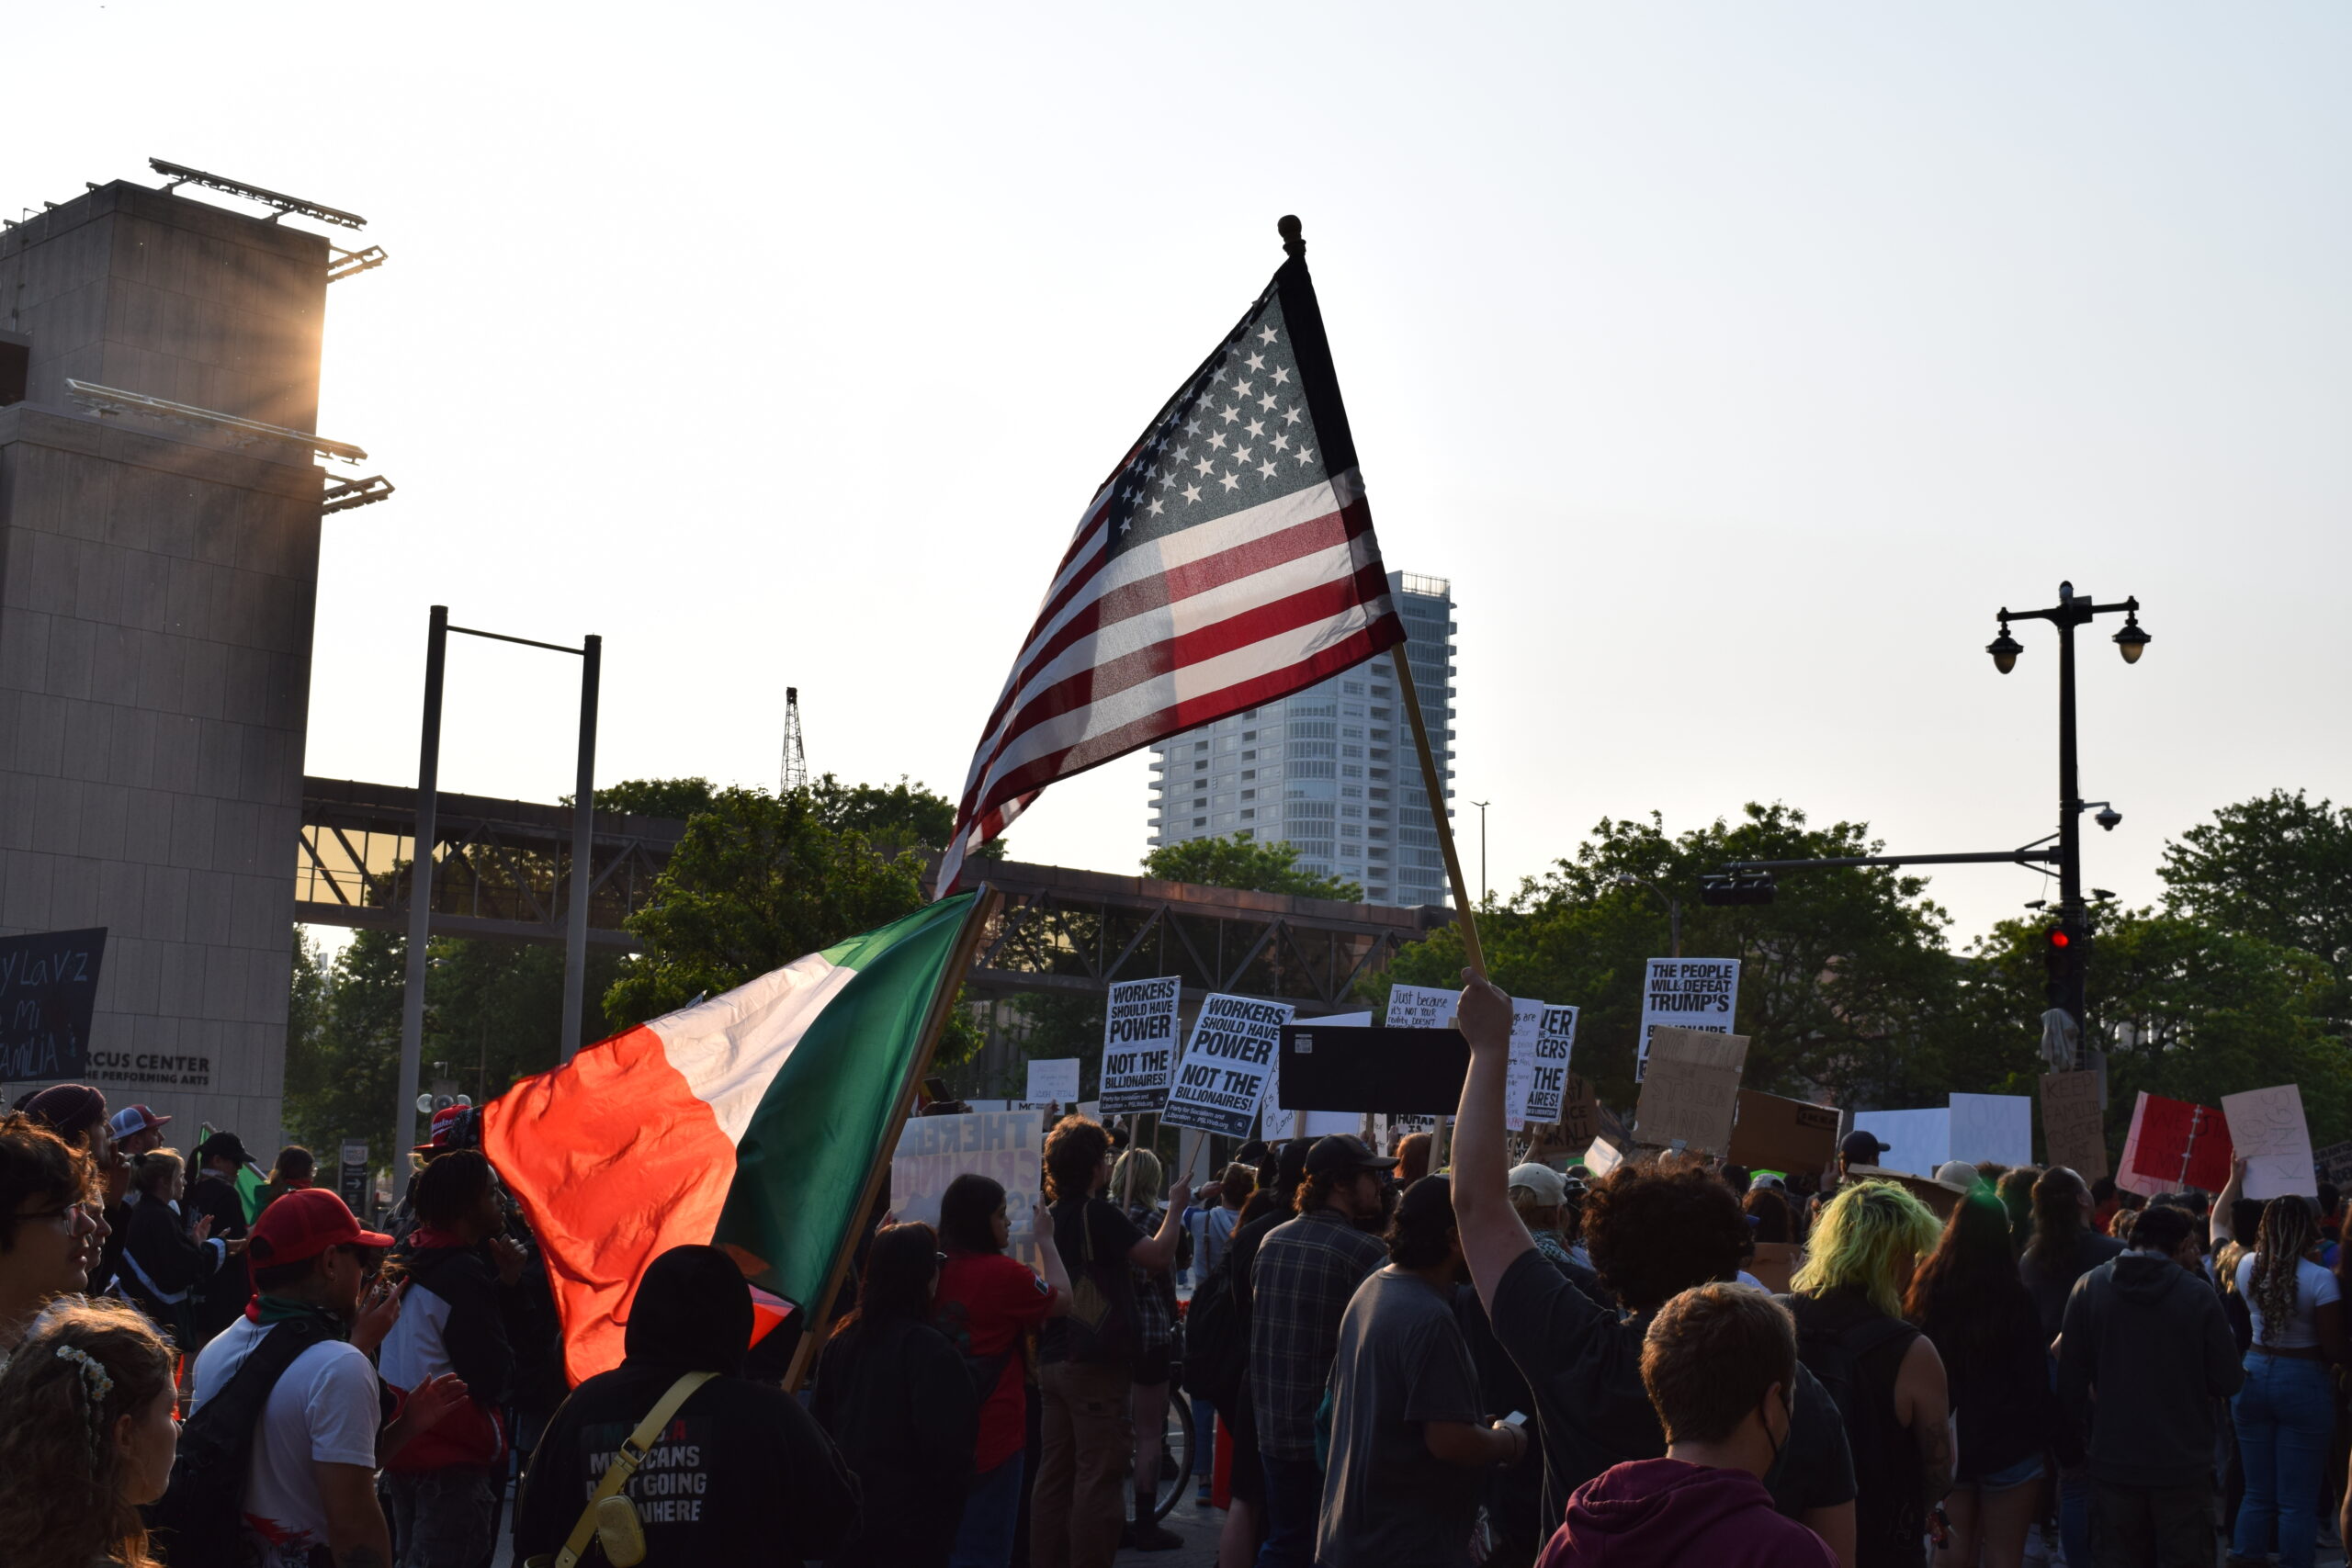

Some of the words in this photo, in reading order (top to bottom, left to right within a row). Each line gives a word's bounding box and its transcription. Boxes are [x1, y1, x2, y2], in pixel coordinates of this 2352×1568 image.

[1653, 964, 1678, 978] THE
[1680, 964, 1733, 979] PEOPLE
[1114, 981, 1175, 1004] WORKERS
[1651, 980, 1679, 993] WILL
[1683, 980, 1732, 994] DEFEAT
[1112, 1003, 1148, 1019] SHOULD
[1149, 999, 1174, 1015] HAVE
[1393, 990, 1414, 1005] Just
[1417, 992, 1449, 1009] because
[1649, 994, 1730, 1012] TRUMP'S
[1208, 998, 1286, 1025] WORKERS
[1387, 1016, 1408, 1026] reality
[1405, 1007, 1418, 1016] NOT
[1420, 1007, 1437, 1018] YOUR
[1109, 1015, 1171, 1043] POWER
[1201, 1016, 1246, 1033] SHOULD
[1247, 1022, 1280, 1041] HAVE
[1192, 1030, 1273, 1066] POWER
[84, 1053, 130, 1069] RCUS
[136, 1054, 209, 1072] CENTER
[1106, 1053, 1138, 1075] NOT
[1140, 1049, 1169, 1072] THE
[85, 1071, 99, 1080] HE
[102, 1071, 177, 1084] PERFORMING
[179, 1073, 209, 1086] ARTS
[1104, 1072, 1168, 1089] BILLIONAIRES!
[1180, 1063, 1222, 1089] NOT
[1222, 1070, 1263, 1098] THE
[1533, 1066, 1564, 1091] THE
[2045, 1072, 2095, 1100] KEEP
[1175, 1086, 1254, 1112] BILLIONAIRES!
[2259, 1089, 2305, 1180] KINGS
[642, 1472, 707, 1496] GOING
